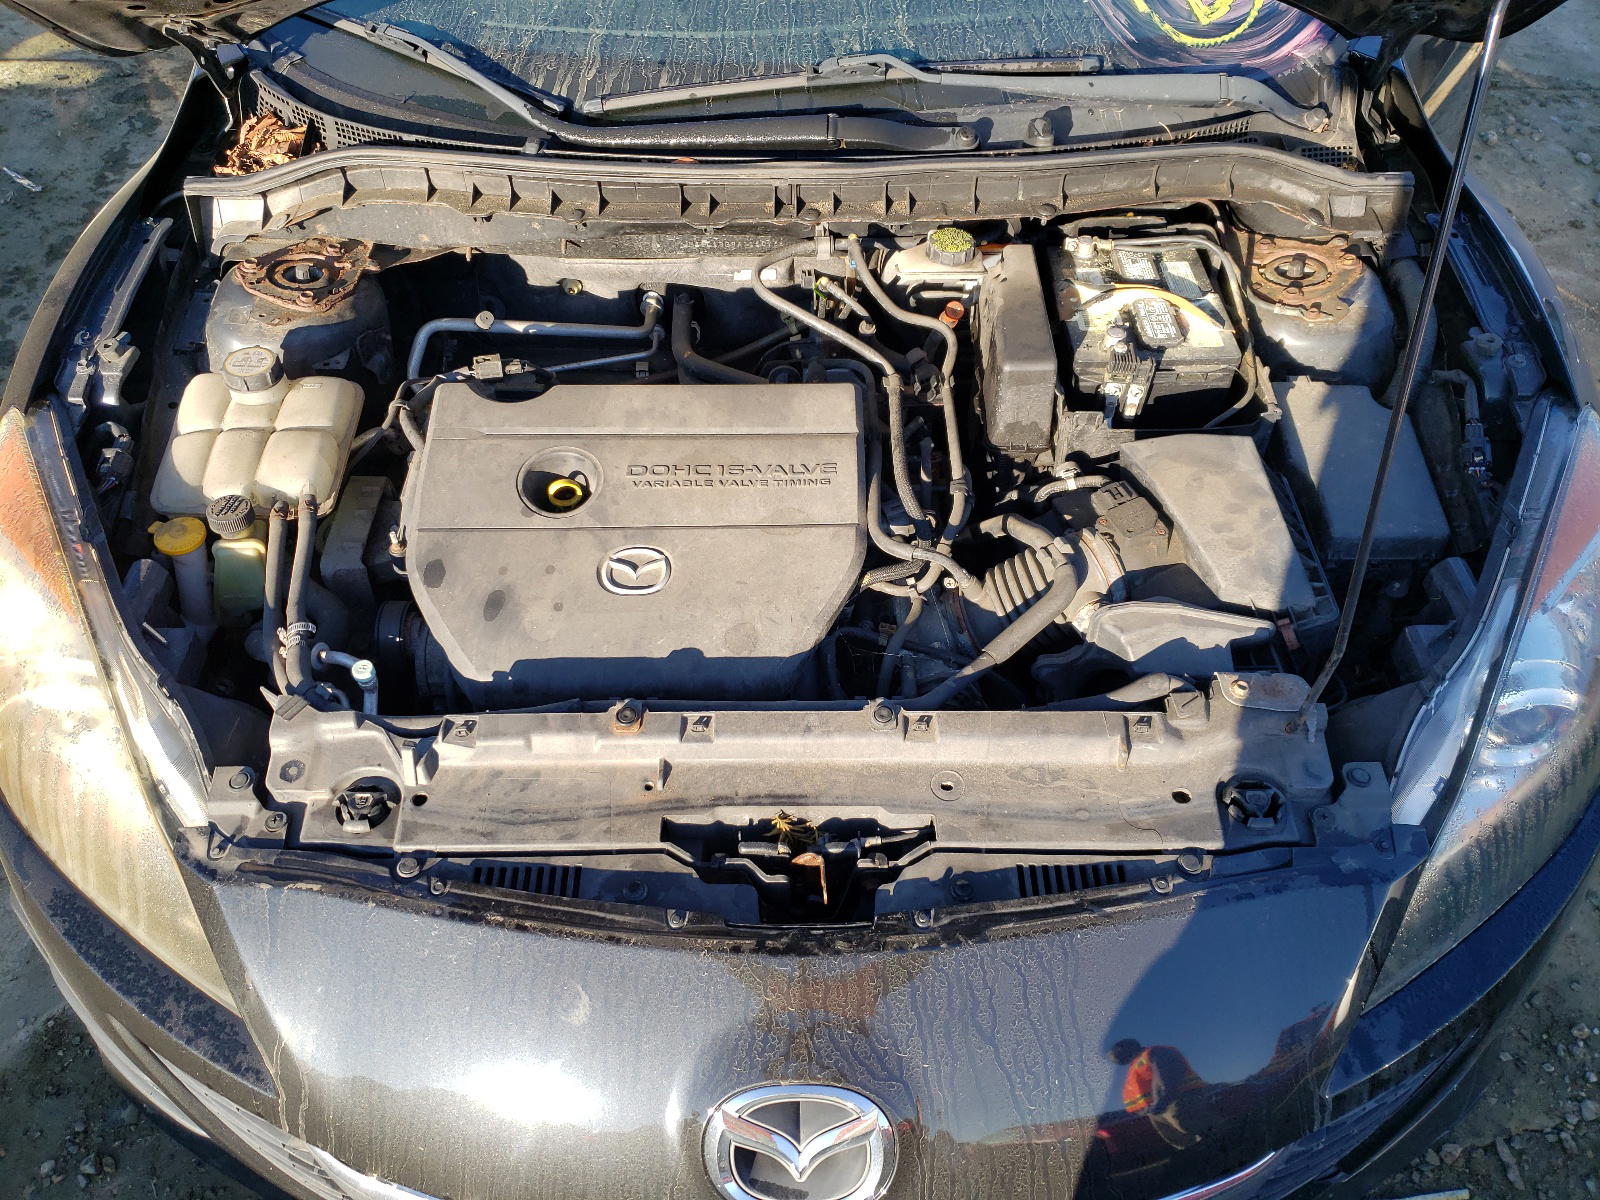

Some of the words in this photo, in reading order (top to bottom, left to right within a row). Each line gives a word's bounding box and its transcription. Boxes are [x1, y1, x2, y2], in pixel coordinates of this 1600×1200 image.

[625, 463, 712, 478] DOHC
[631, 479, 714, 488] VARIABLE
[718, 479, 769, 488] VALVE
[772, 477, 832, 488] TIMING
